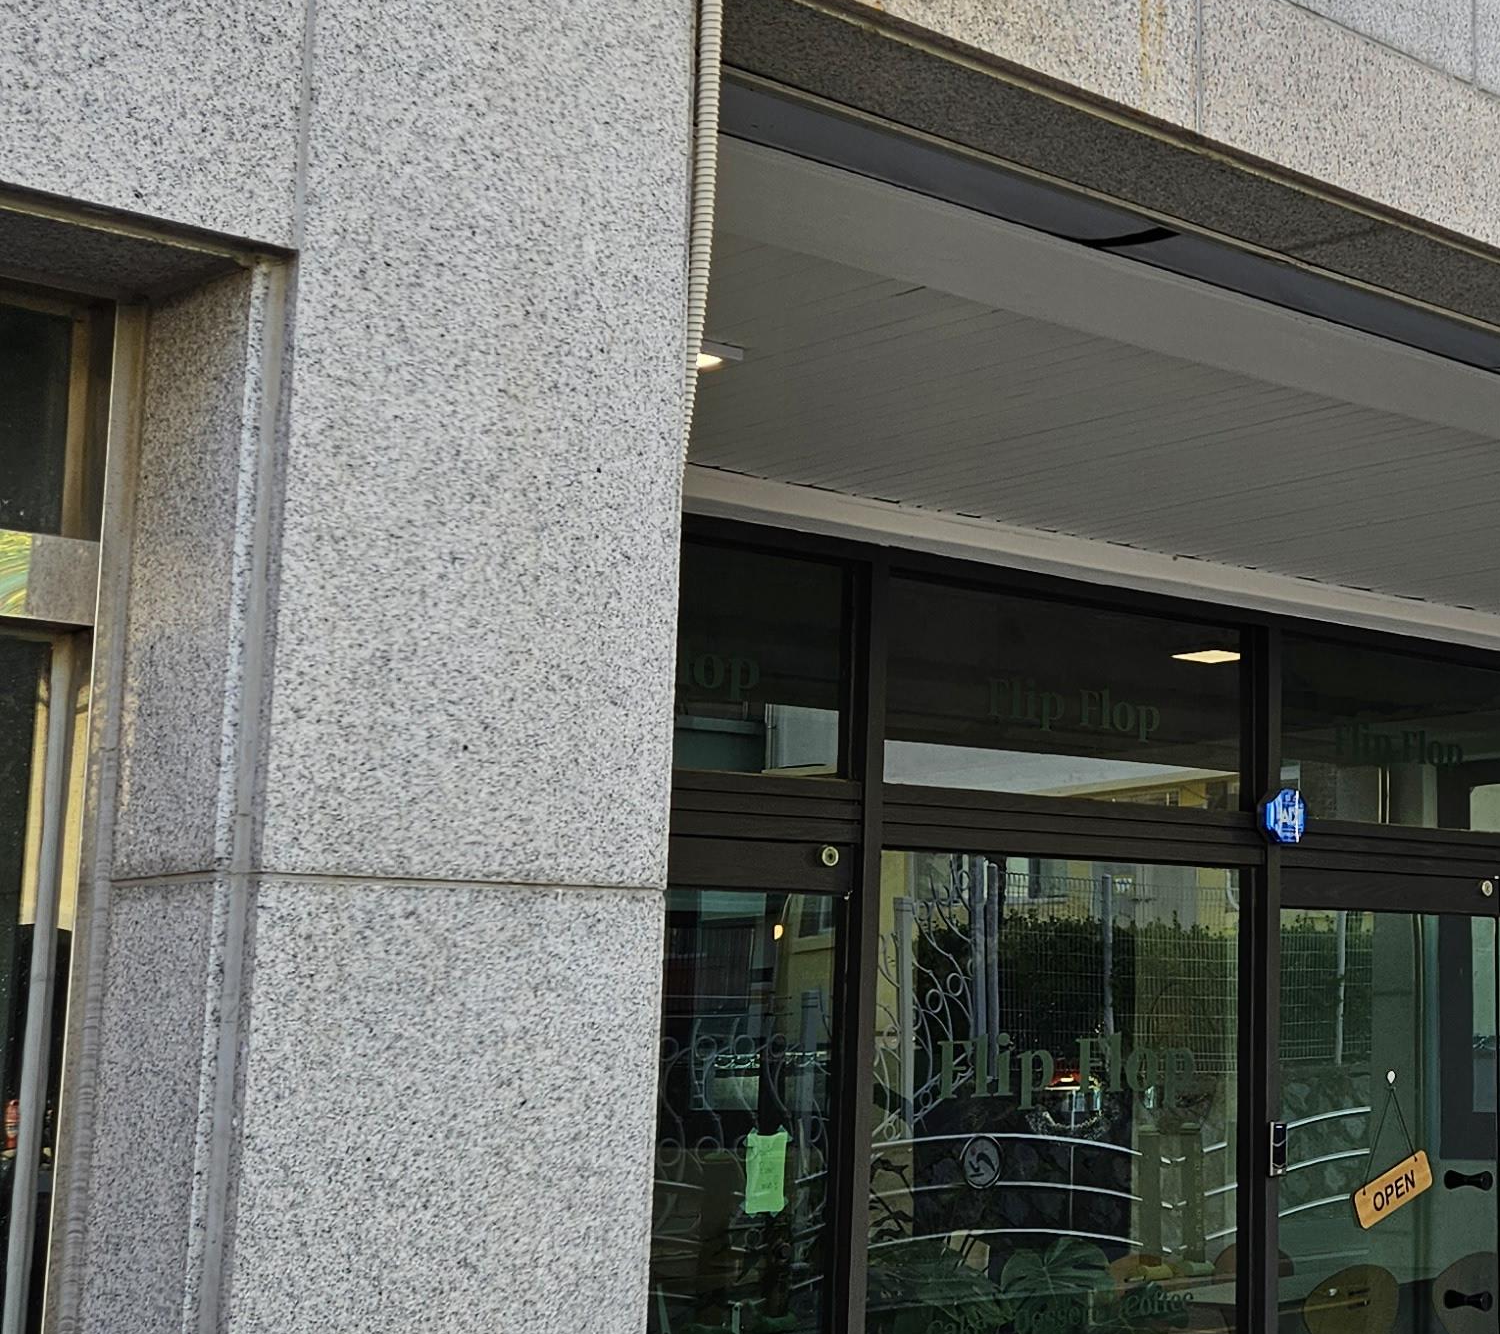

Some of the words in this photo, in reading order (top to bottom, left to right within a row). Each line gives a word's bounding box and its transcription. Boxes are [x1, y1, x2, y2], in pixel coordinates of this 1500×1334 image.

[987, 676, 1066, 732] Flip
[1078, 682, 1162, 743] Flop
[937, 1031, 1056, 1110] Flip
[1075, 1030, 1195, 1109] Flop
[1373, 1169, 1416, 1212] OPEN
[1122, 1283, 1195, 1317] Coffee
